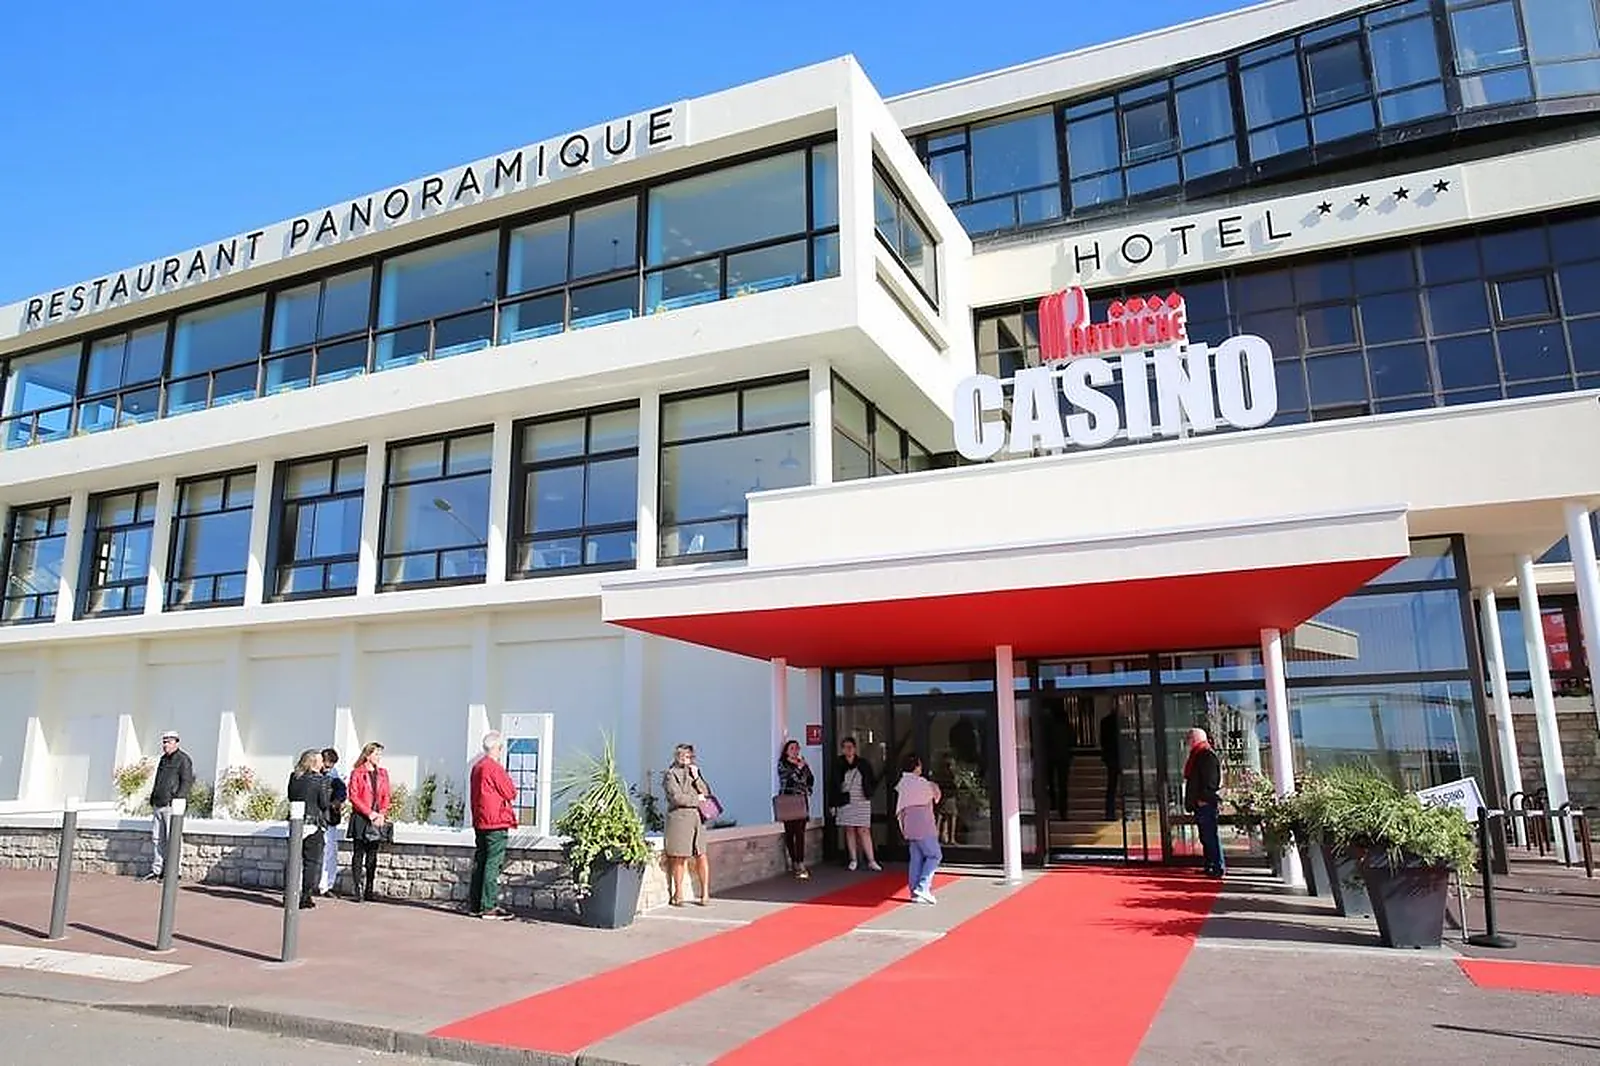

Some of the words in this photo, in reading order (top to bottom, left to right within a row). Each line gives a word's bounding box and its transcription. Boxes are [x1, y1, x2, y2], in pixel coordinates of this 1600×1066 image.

[27, 233, 264, 324] RESTAURANT
[290, 108, 673, 248] PANORAMIQUE
[1074, 211, 1292, 273] HOTEL
[954, 335, 1278, 461] CASINO
